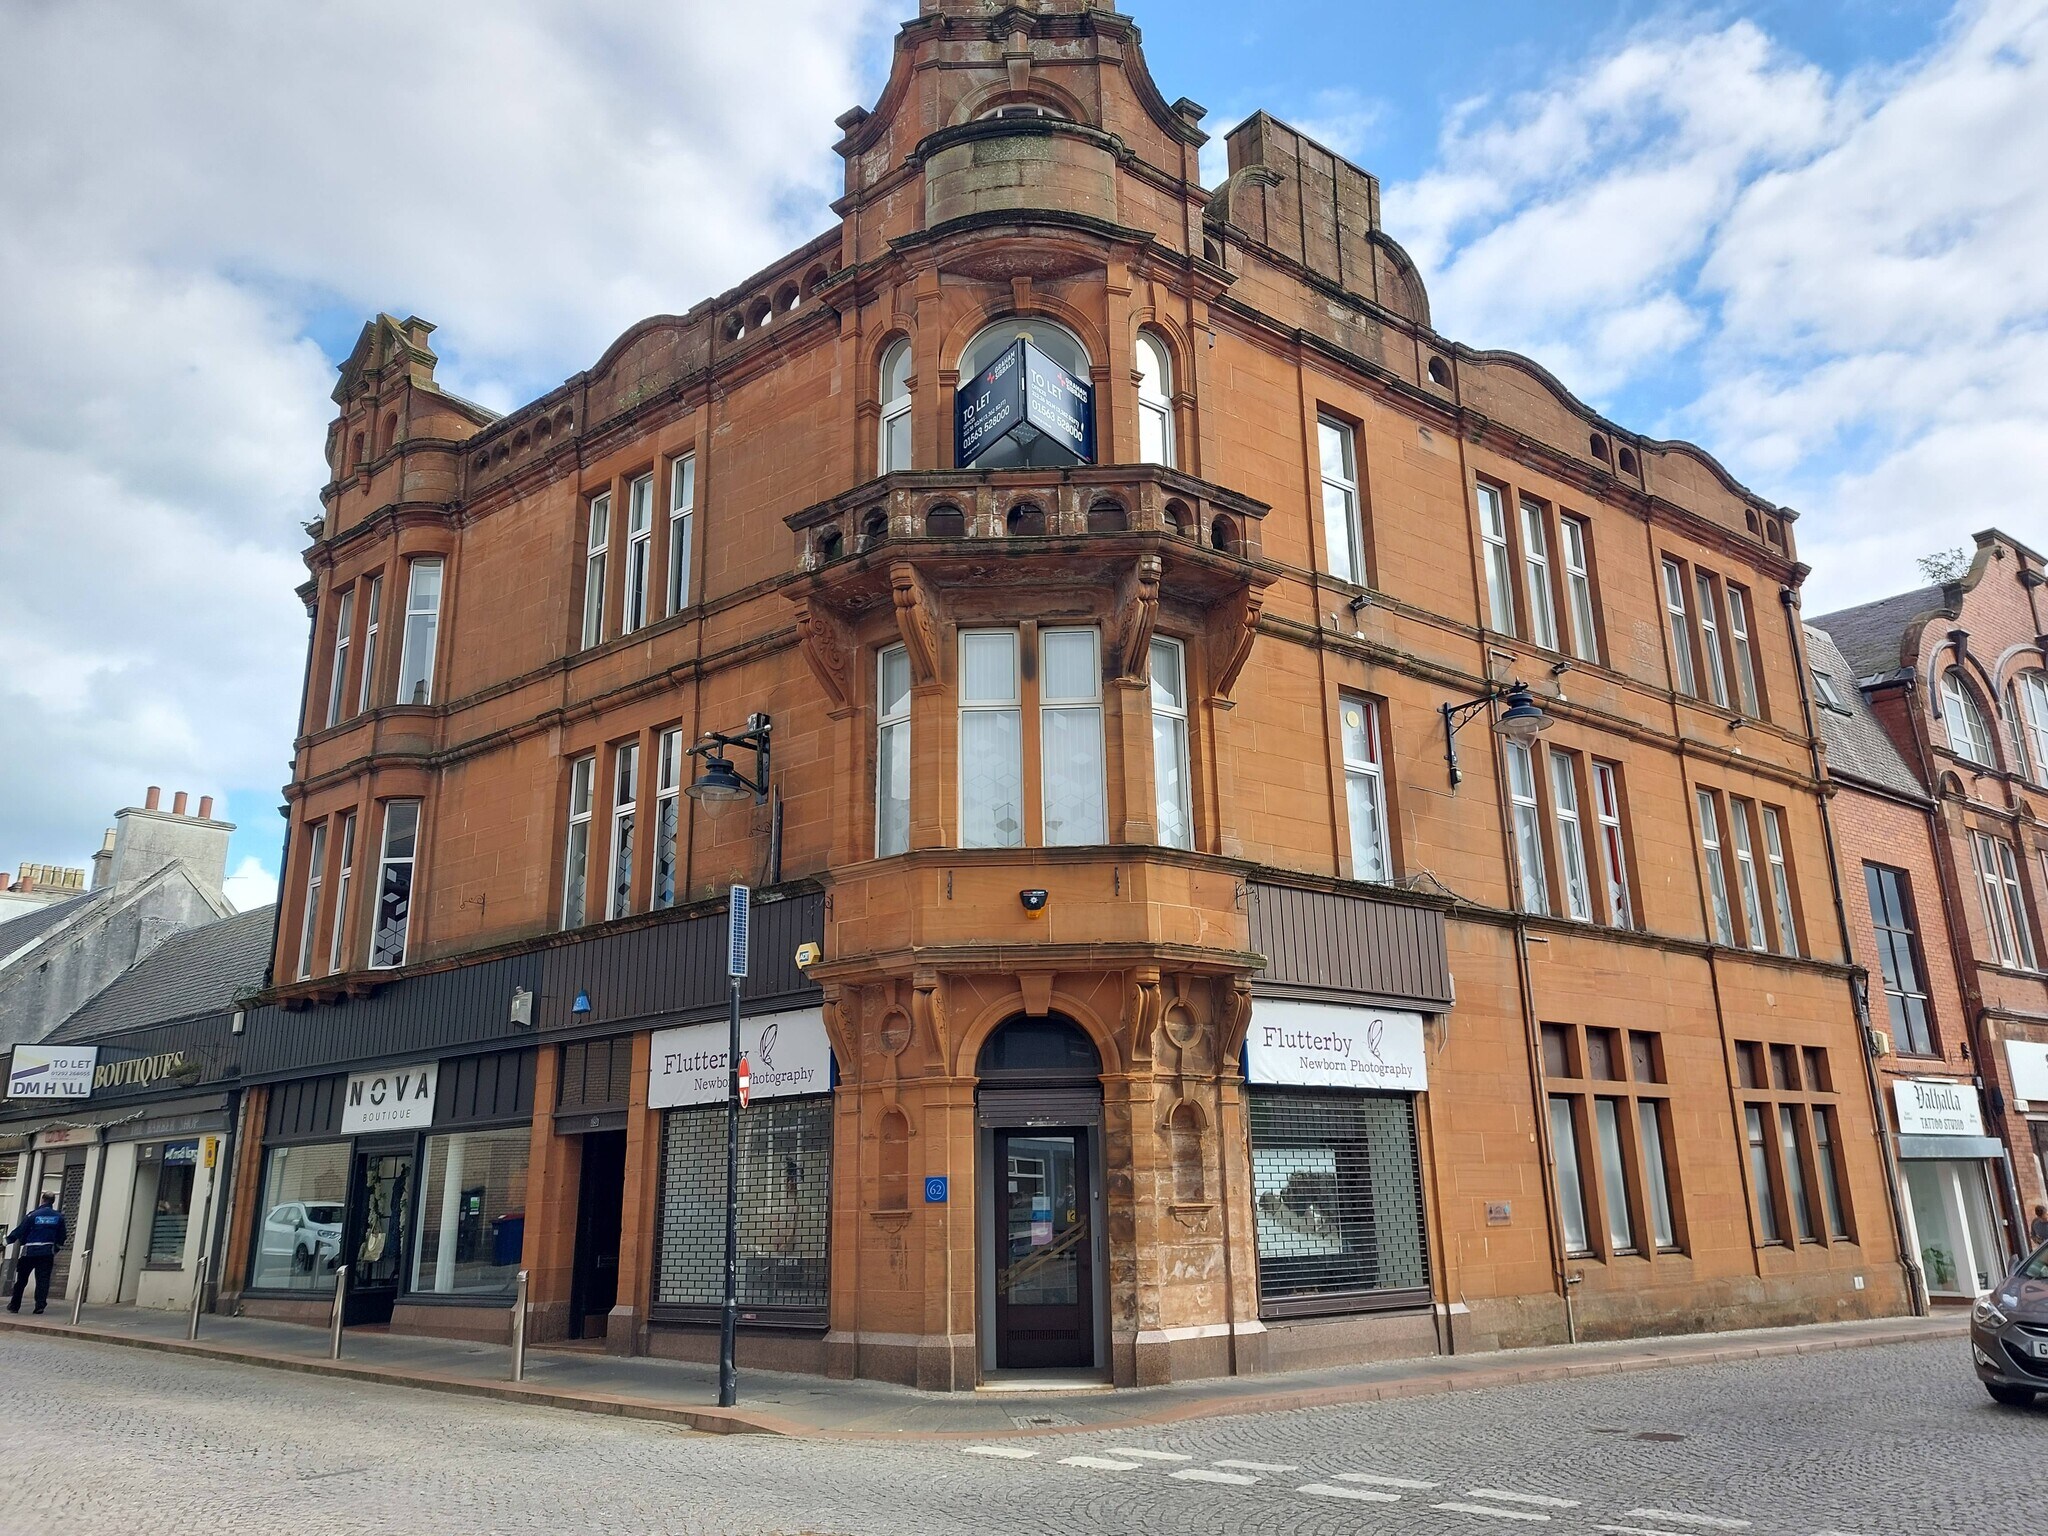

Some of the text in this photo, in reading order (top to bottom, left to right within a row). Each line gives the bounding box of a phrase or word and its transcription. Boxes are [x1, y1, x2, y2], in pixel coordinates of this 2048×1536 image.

[995, 350, 1015, 373] GRAHAM
[995, 358, 1015, 380] SIBBALD
[1031, 369, 1063, 400] TO LET
[1065, 378, 1087, 397] GRAHAM
[1066, 384, 1087, 403] SIBBALD
[963, 391, 991, 422] TO LET
[963, 428, 983, 449] 01563
[984, 405, 1010, 432] 528000
[1032, 400, 1055, 421] 01563
[1057, 416, 1083, 442] 528000
[1262, 1026, 1353, 1058] Flutterby
[53, 1060, 91, 1068] TO LET
[1300, 1056, 1413, 1078] Newborn Photography
[13, 1082, 40, 1094] DM
[349, 1073, 428, 1106] NOVA
[694, 1077, 730, 1091] Newbo
[1914, 1085, 1962, 1114] Valhalla
[363, 1109, 411, 1122] BOUTIQUE
[1920, 1117, 1943, 1130] TATTOO
[1944, 1118, 1964, 1130] STUDIO
[930, 1184, 942, 1195] 62
